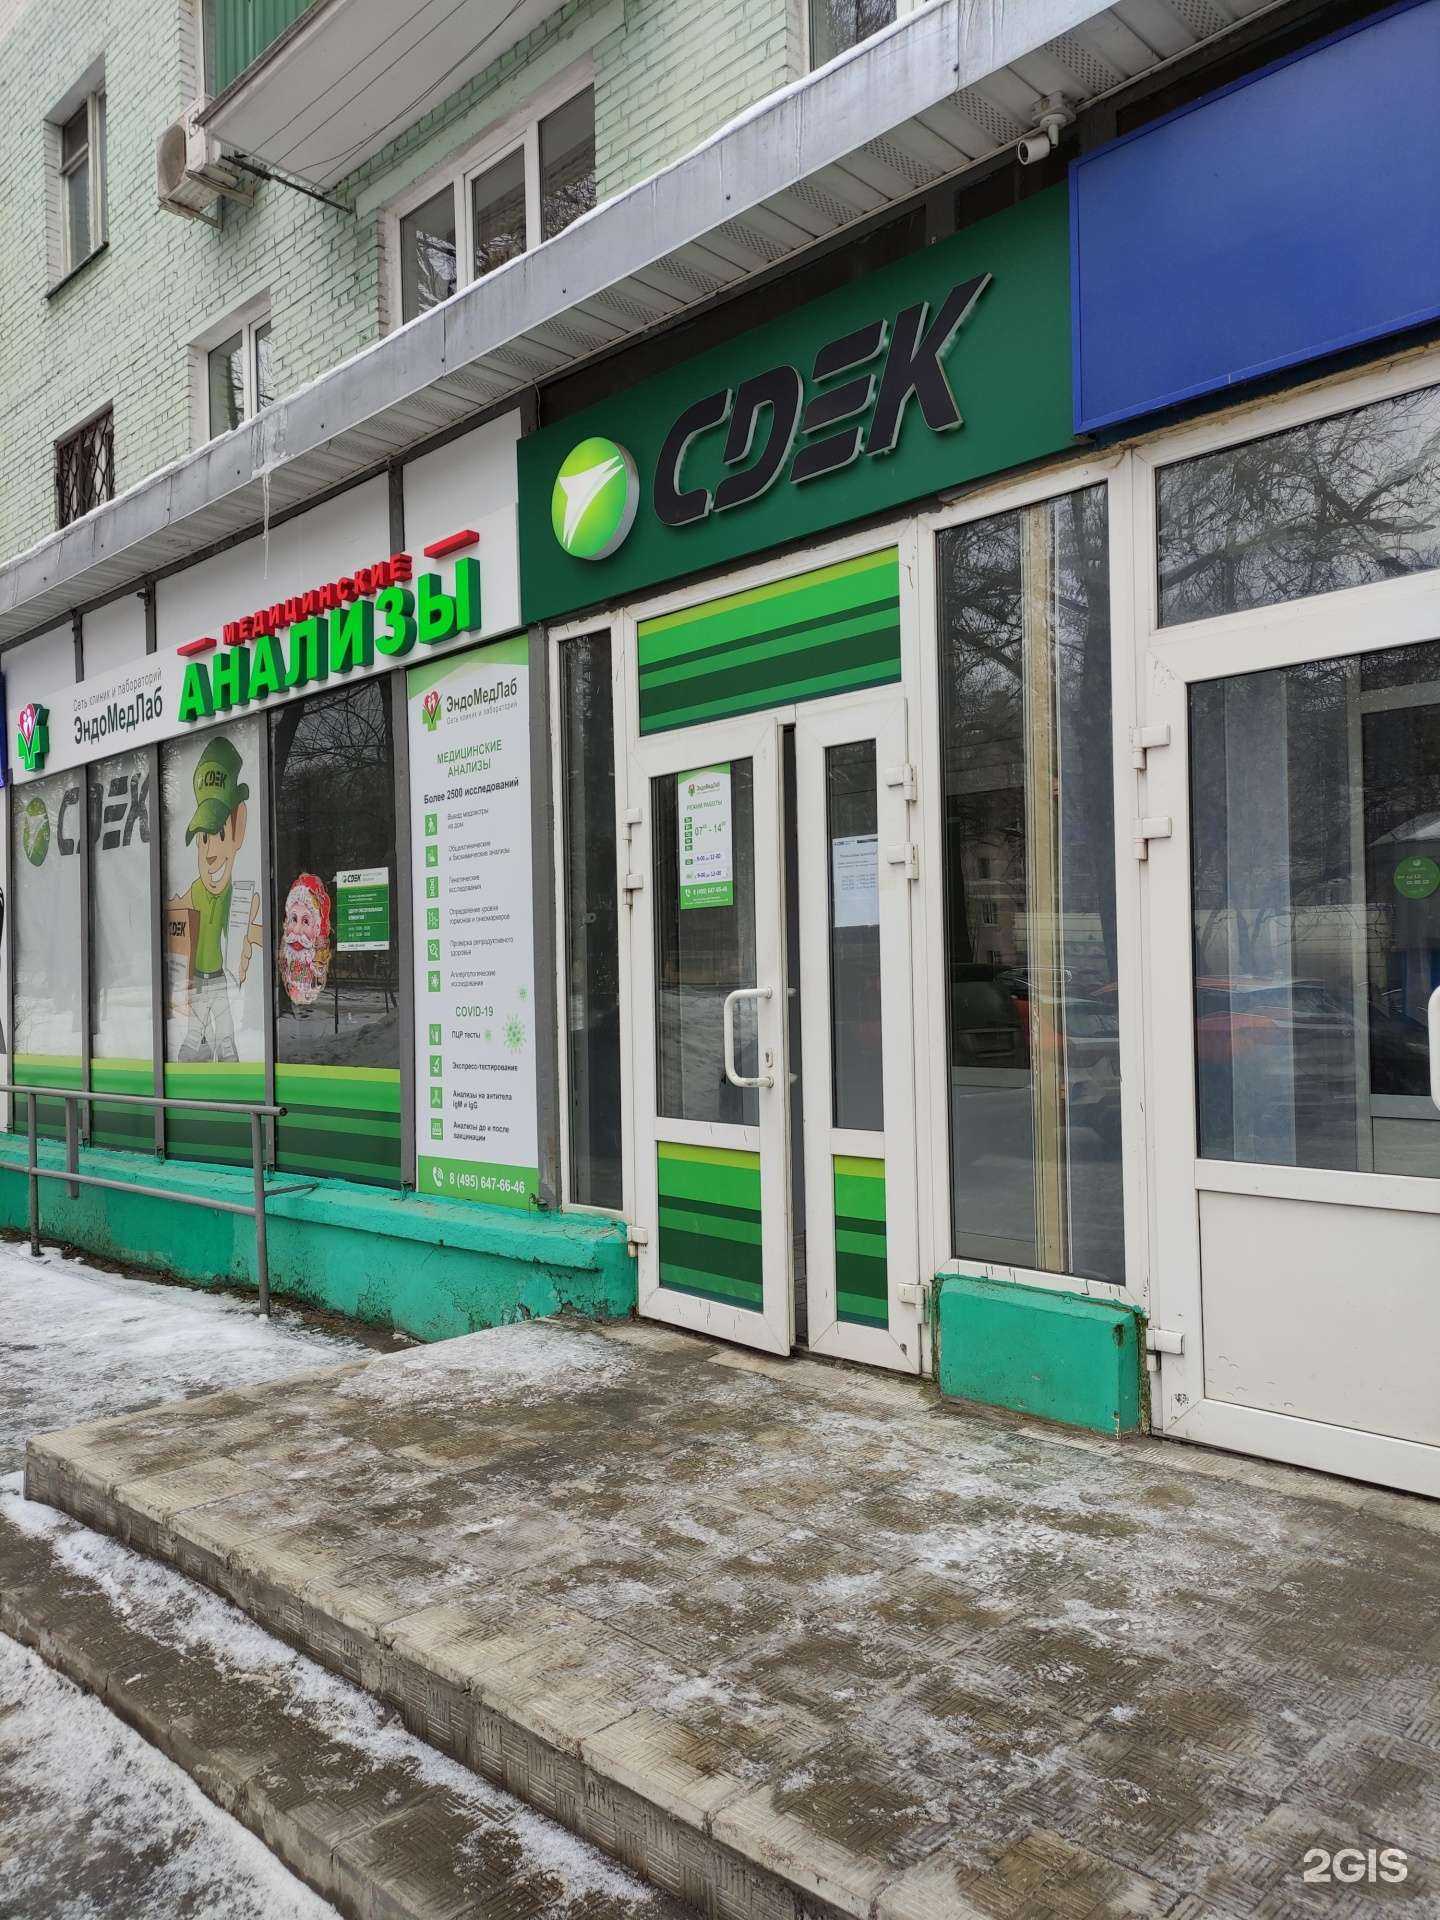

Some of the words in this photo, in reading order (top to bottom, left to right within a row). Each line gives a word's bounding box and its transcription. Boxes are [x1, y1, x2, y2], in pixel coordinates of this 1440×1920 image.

[653, 272, 994, 527] CDEK
[223, 553, 413, 646] МЕДИЦИНСКИЕ
[178, 557, 482, 723] АНАЛИЗЫ
[73, 699, 88, 712] Сеть
[90, 690, 110, 706] клиник
[117, 667, 162, 696] лабораторий
[446, 677, 518, 712] ЭндоМедЛаб
[74, 686, 163, 744] ЭндоМедЛаб
[437, 739, 502, 764] МЕДИЦИНСКИЕ
[447, 758, 491, 778] АНАЛИЗЫ
[424, 792, 446, 804] Более
[447, 788, 463, 800] 2500
[464, 776, 519, 796] исследований
[455, 1006, 494, 1017] COVID-19
[452, 1031, 464, 1040] ПЦР
[464, 1031, 480, 1039] тесты
[453, 1090, 477, 1099] Анализы
[453, 1121, 478, 1131] Анализы
[449, 1172, 455, 1184] 8
[457, 1174, 478, 1190] (495)
[480, 1176, 525, 1194] 647-66-46
